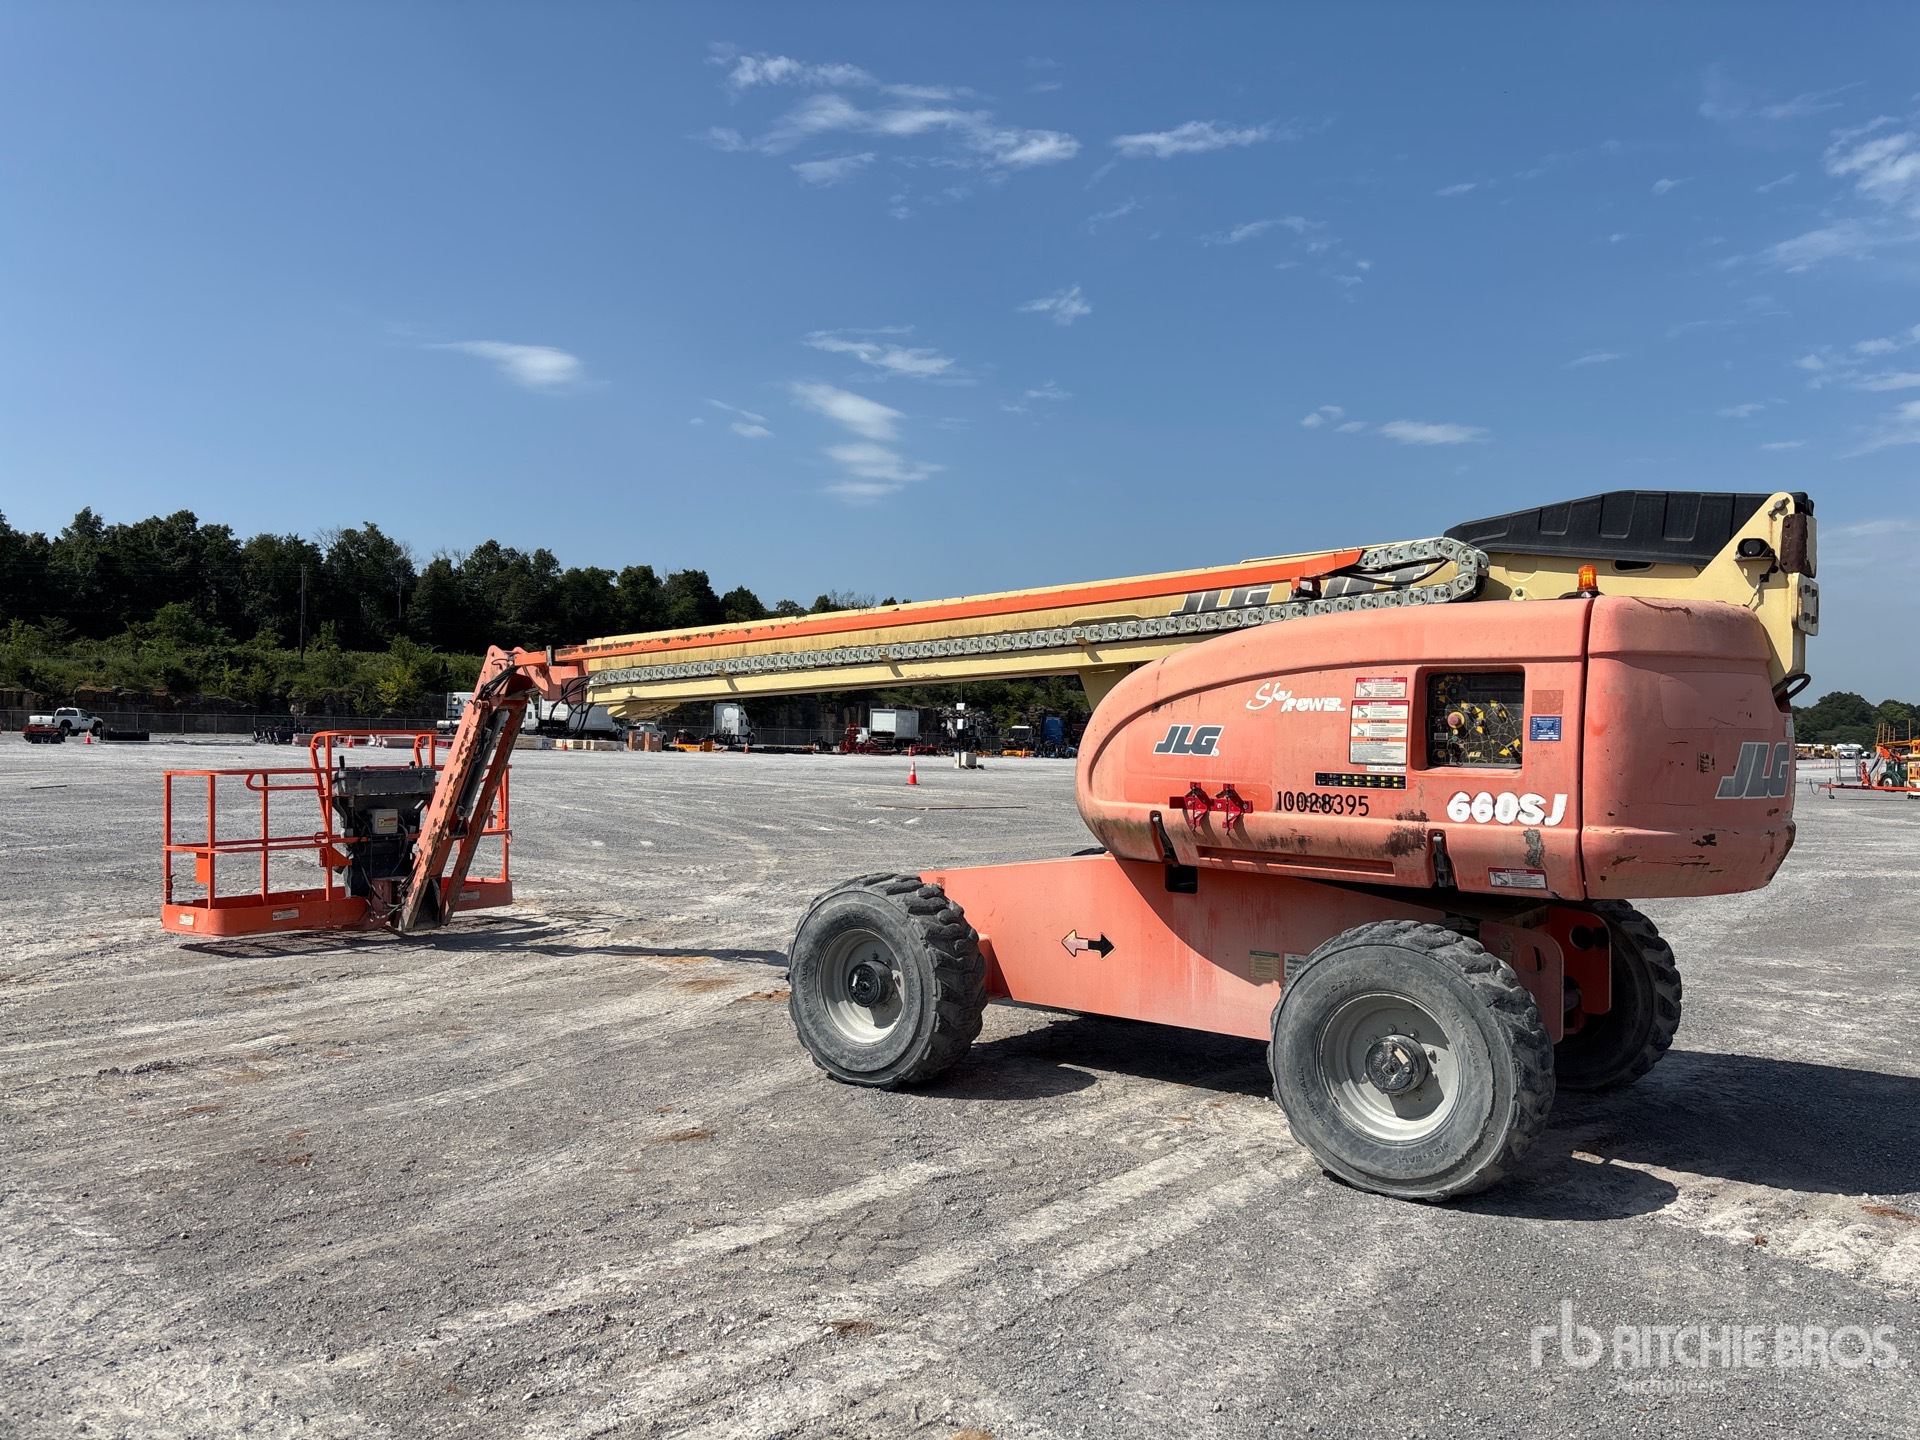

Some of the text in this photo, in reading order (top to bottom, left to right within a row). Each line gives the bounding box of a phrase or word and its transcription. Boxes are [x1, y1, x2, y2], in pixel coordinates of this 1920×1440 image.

[1169, 583, 1274, 617] JLG
[1245, 681, 1293, 711] Sky
[1153, 724, 1225, 756] JLG
[1714, 742, 1791, 799] JLG
[1276, 790, 1370, 817] 10028395
[1446, 791, 1569, 827] 660SJ
